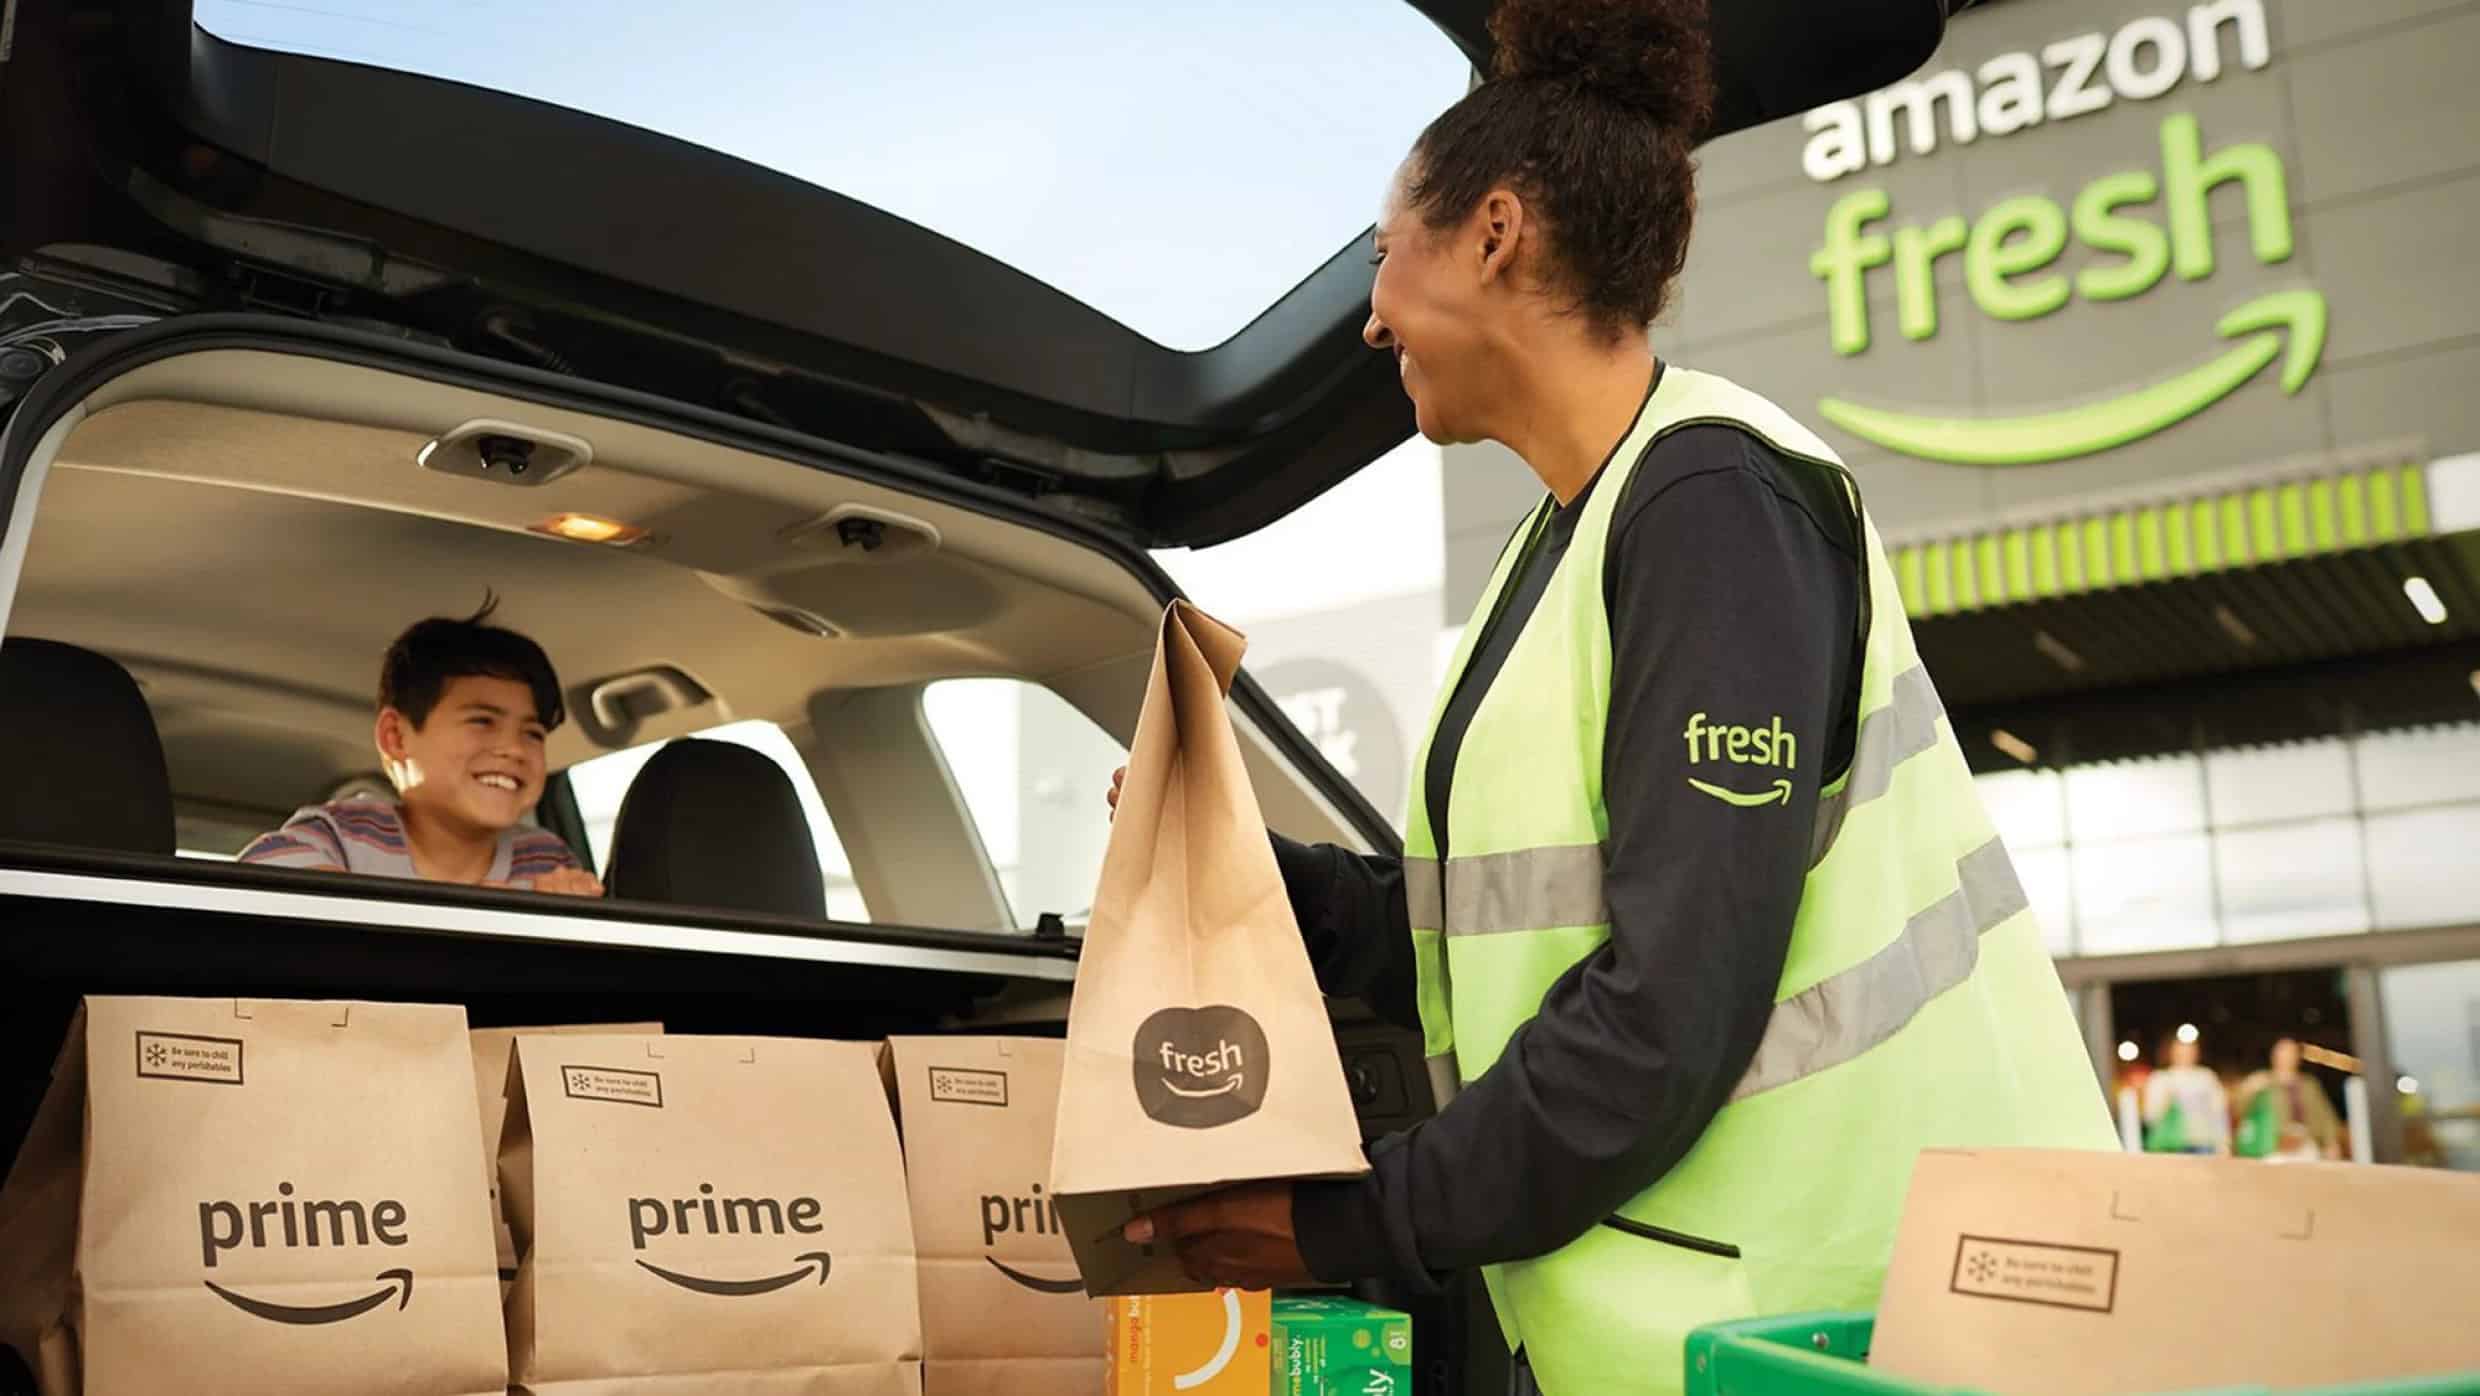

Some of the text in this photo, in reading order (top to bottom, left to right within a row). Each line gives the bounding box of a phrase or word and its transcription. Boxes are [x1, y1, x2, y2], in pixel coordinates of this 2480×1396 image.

[1802, 0, 2270, 181] amazon
[1808, 112, 2293, 356] fresh
[1683, 712, 1797, 769] fresh
[1160, 1039, 1243, 1077] fresh
[199, 1181, 409, 1267] prime
[628, 1182, 824, 1250] prime
